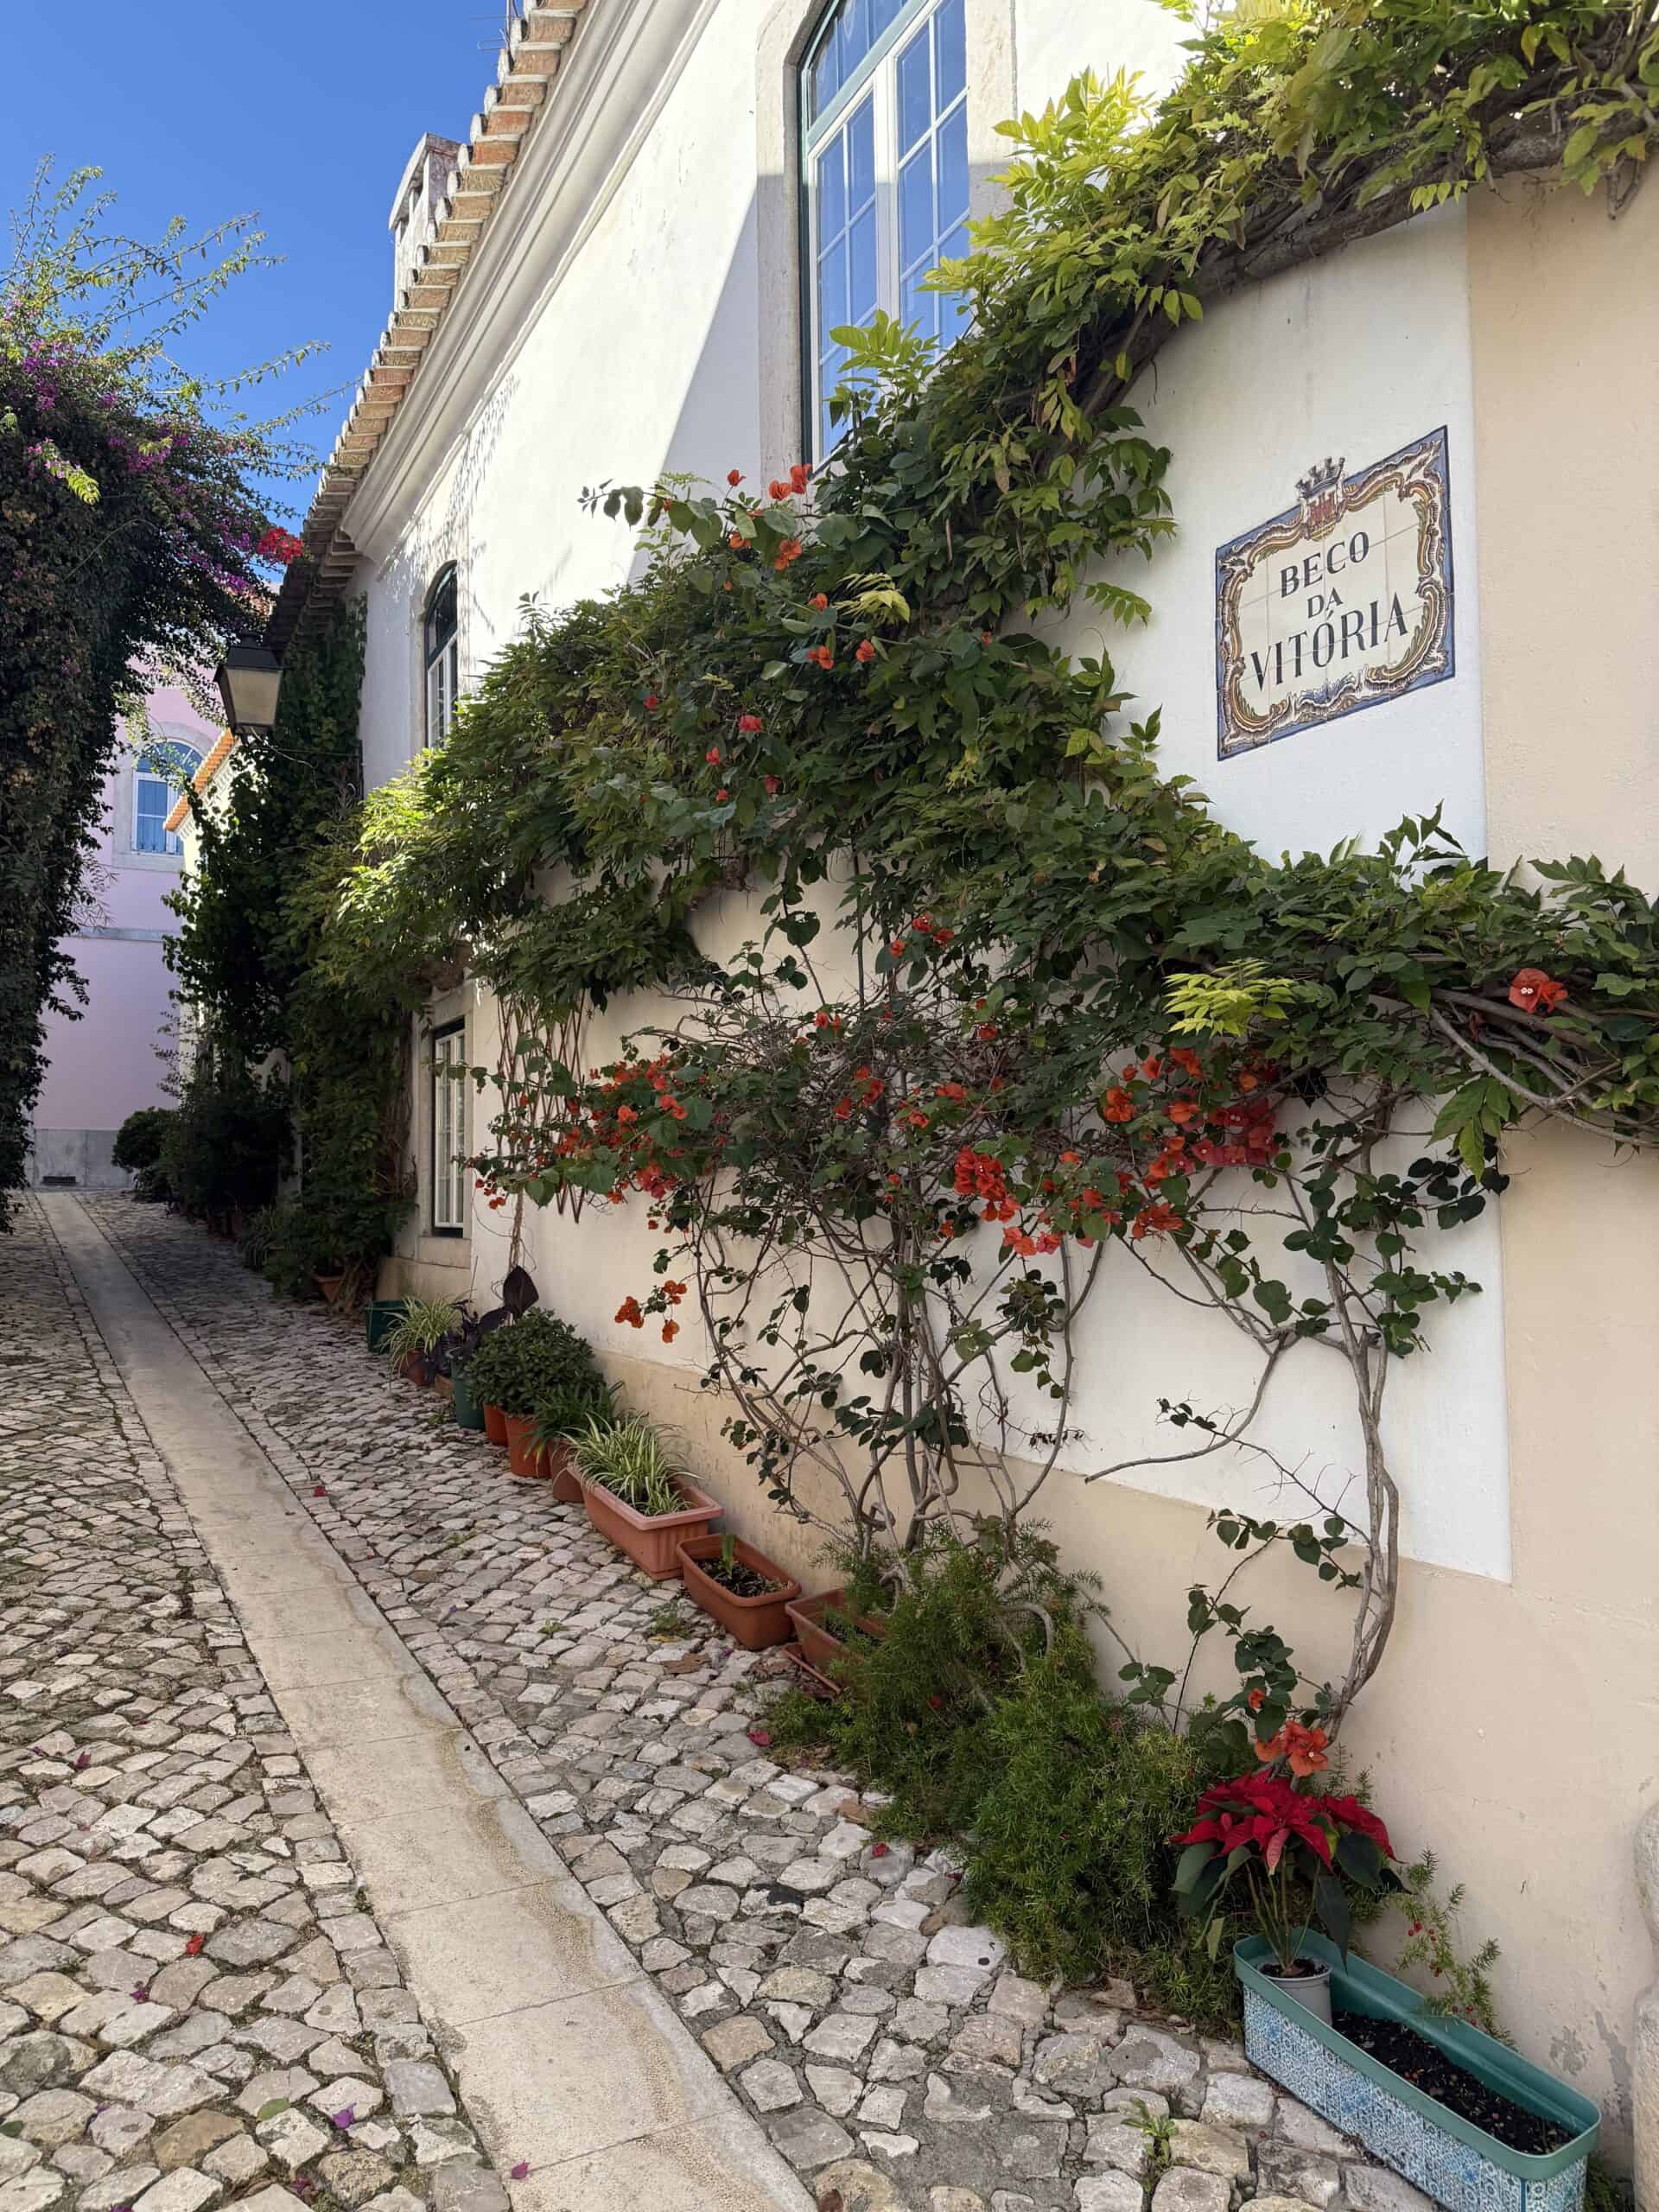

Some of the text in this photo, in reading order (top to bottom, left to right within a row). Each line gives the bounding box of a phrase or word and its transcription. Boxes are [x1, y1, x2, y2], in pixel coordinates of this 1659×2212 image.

[1281, 531, 1369, 598] BECO
[1307, 587, 1344, 619] DA
[1251, 592, 1408, 691] VITÓRIA
